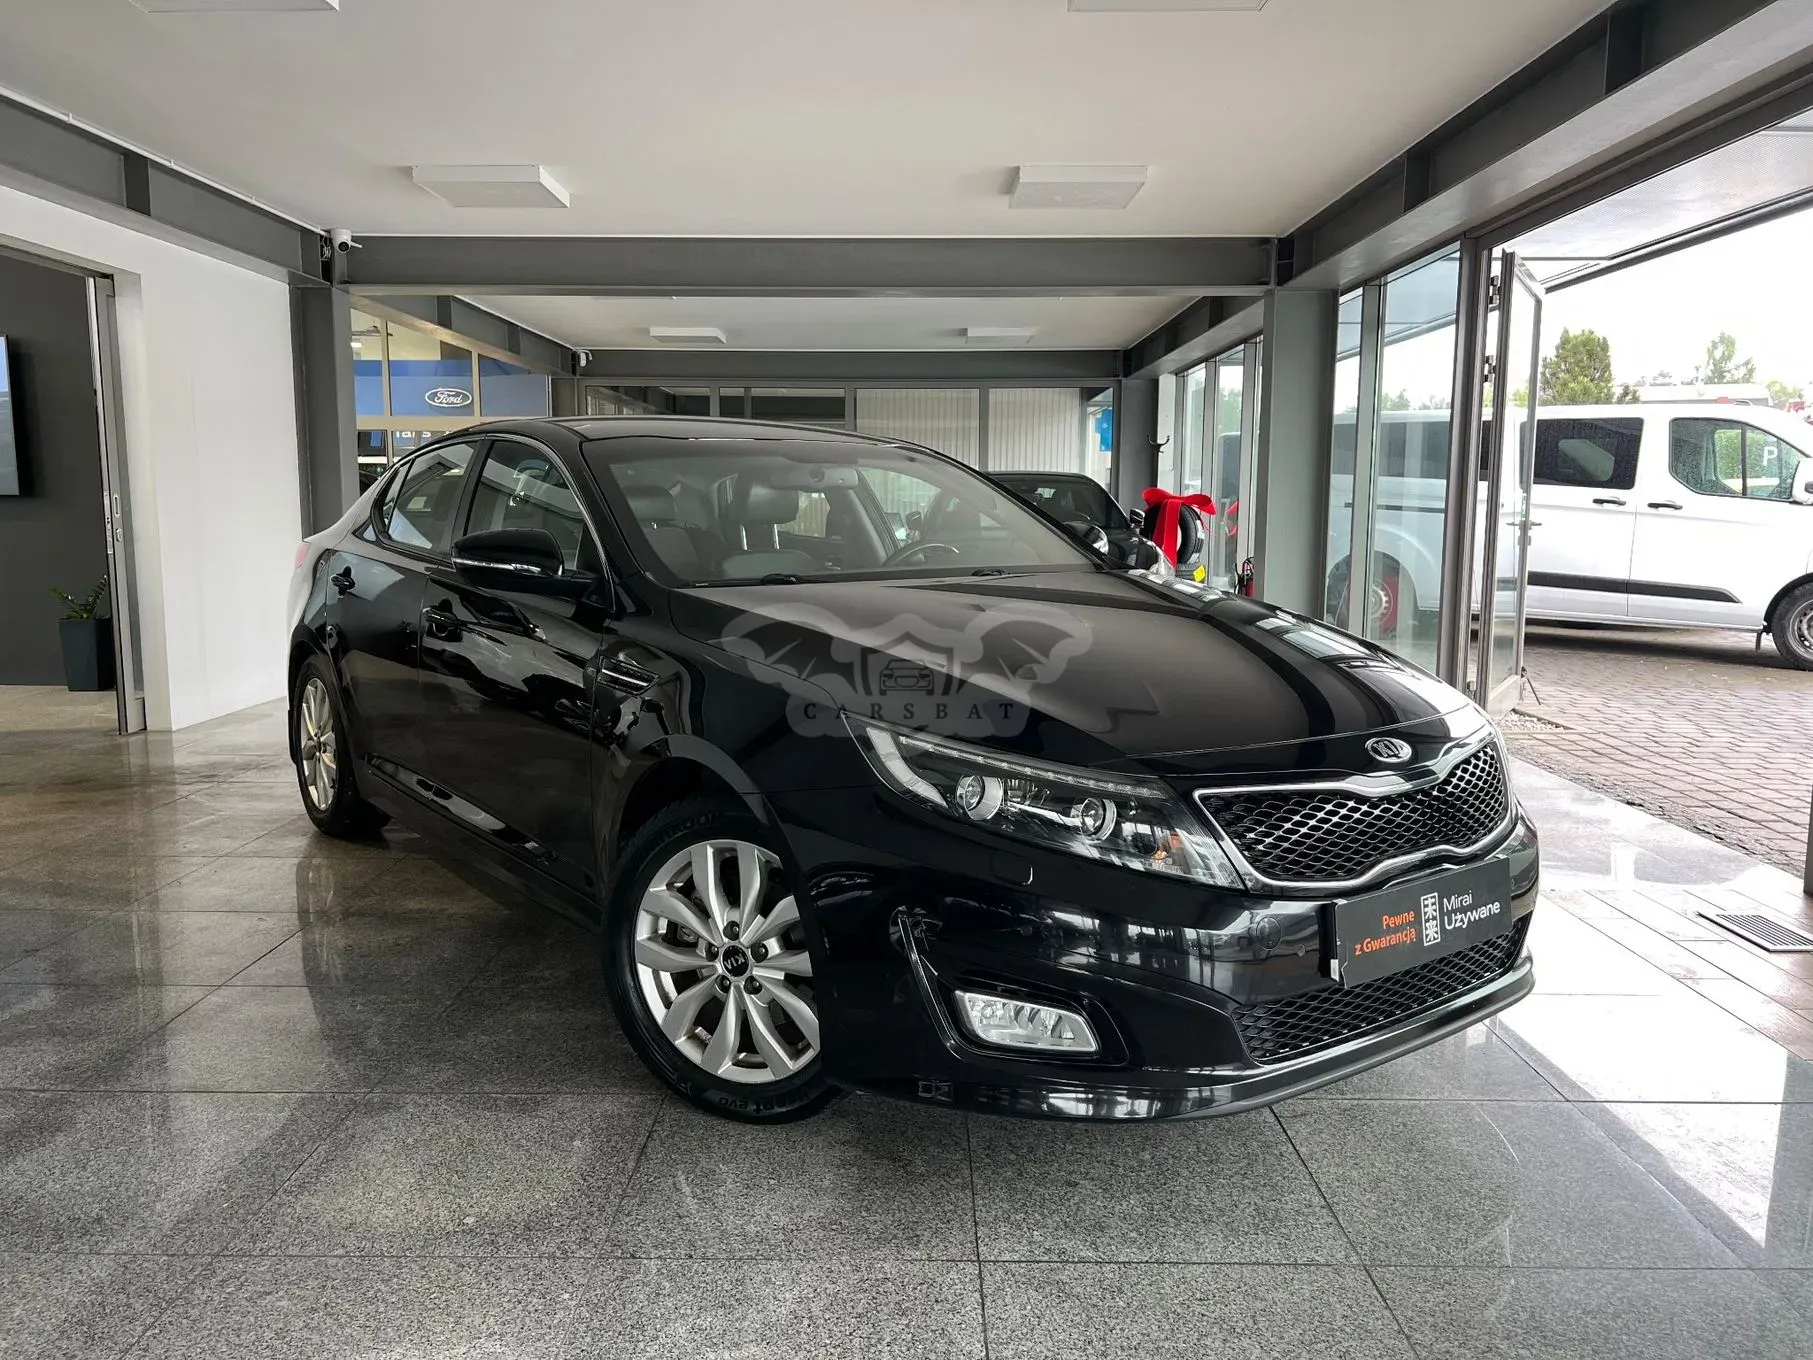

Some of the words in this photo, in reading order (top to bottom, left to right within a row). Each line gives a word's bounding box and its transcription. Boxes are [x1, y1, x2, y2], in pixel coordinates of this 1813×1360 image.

[1762, 446, 1778, 466] P
[1443, 890, 1473, 913] Mirai
[1382, 909, 1415, 930] Pewne
[1444, 900, 1501, 931] Używane
[1355, 943, 1362, 956] z
[1363, 928, 1417, 953] Gwarancją
[723, 952, 746, 970] KIA
